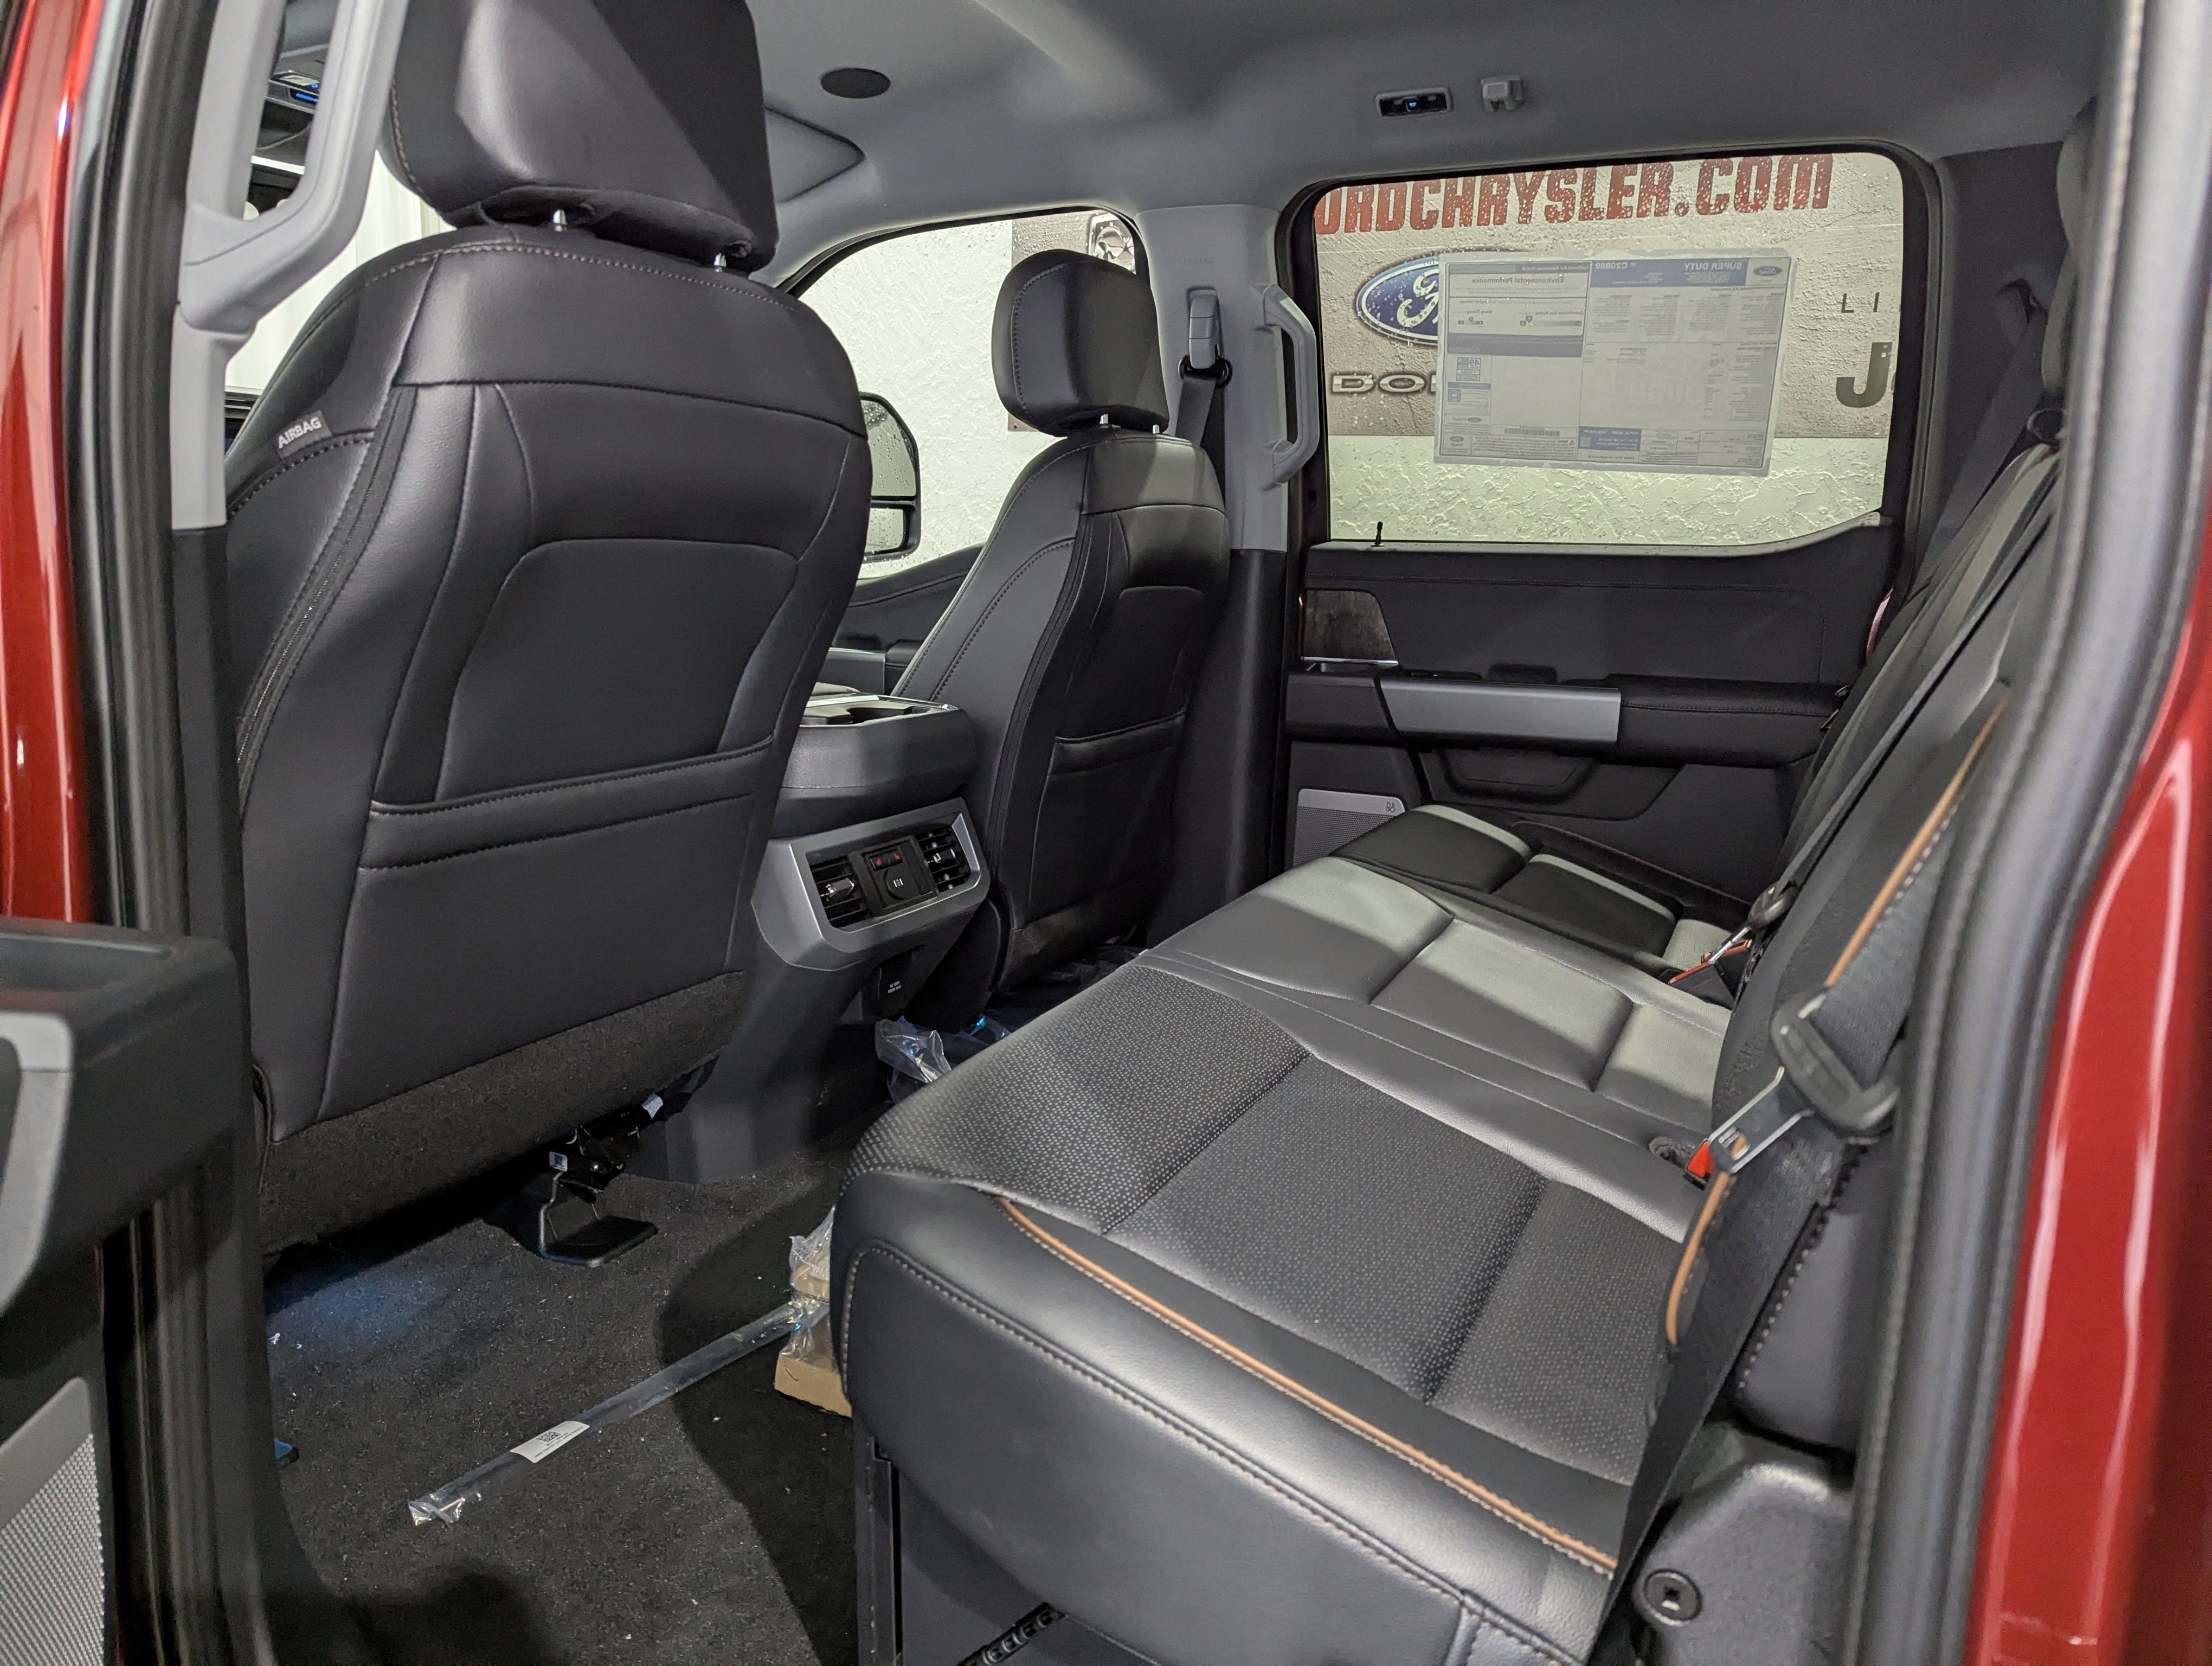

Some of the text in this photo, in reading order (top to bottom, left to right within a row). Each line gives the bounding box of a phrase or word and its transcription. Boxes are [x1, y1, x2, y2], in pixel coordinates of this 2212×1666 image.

[1332, 374, 1437, 393] DO
[1836, 342, 1895, 408] J
[278, 416, 322, 449] AIRBAG
